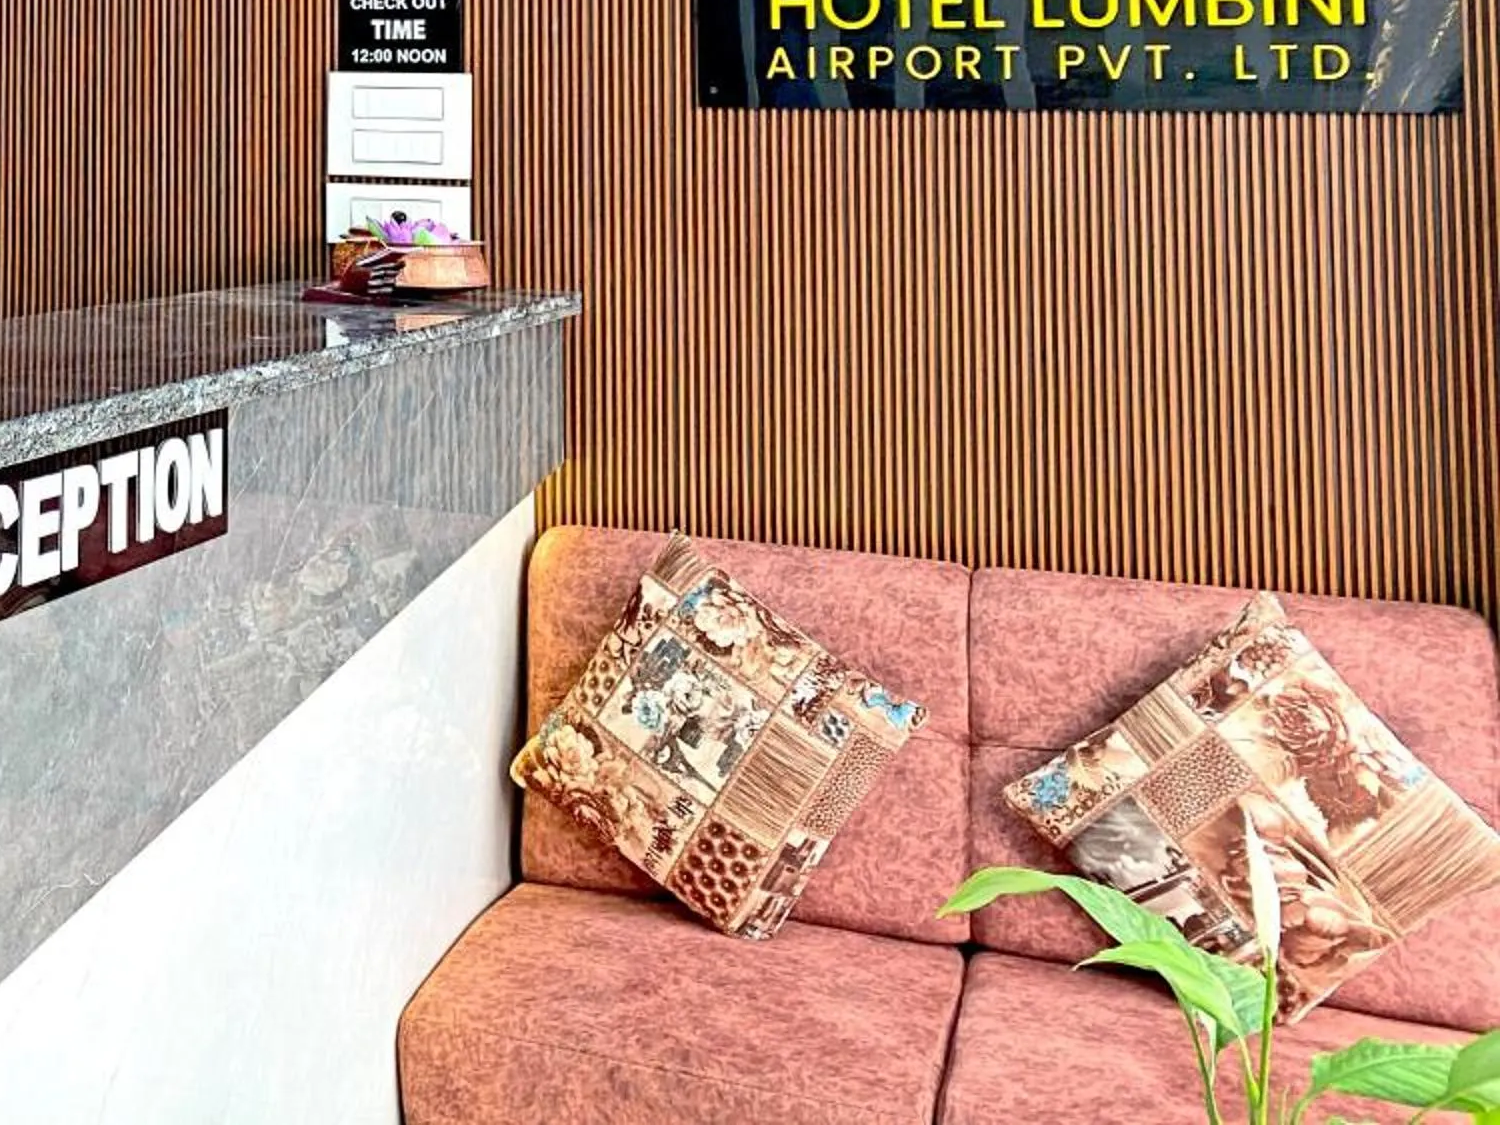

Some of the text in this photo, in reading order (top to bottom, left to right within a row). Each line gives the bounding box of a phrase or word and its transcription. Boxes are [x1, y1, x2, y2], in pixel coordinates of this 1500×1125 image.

[370, 19, 426, 40] TIME
[351, 48, 447, 63] 12:00 NOON
[765, 45, 1021, 81] AIRPORT
[1058, 44, 1196, 81] PVT.
